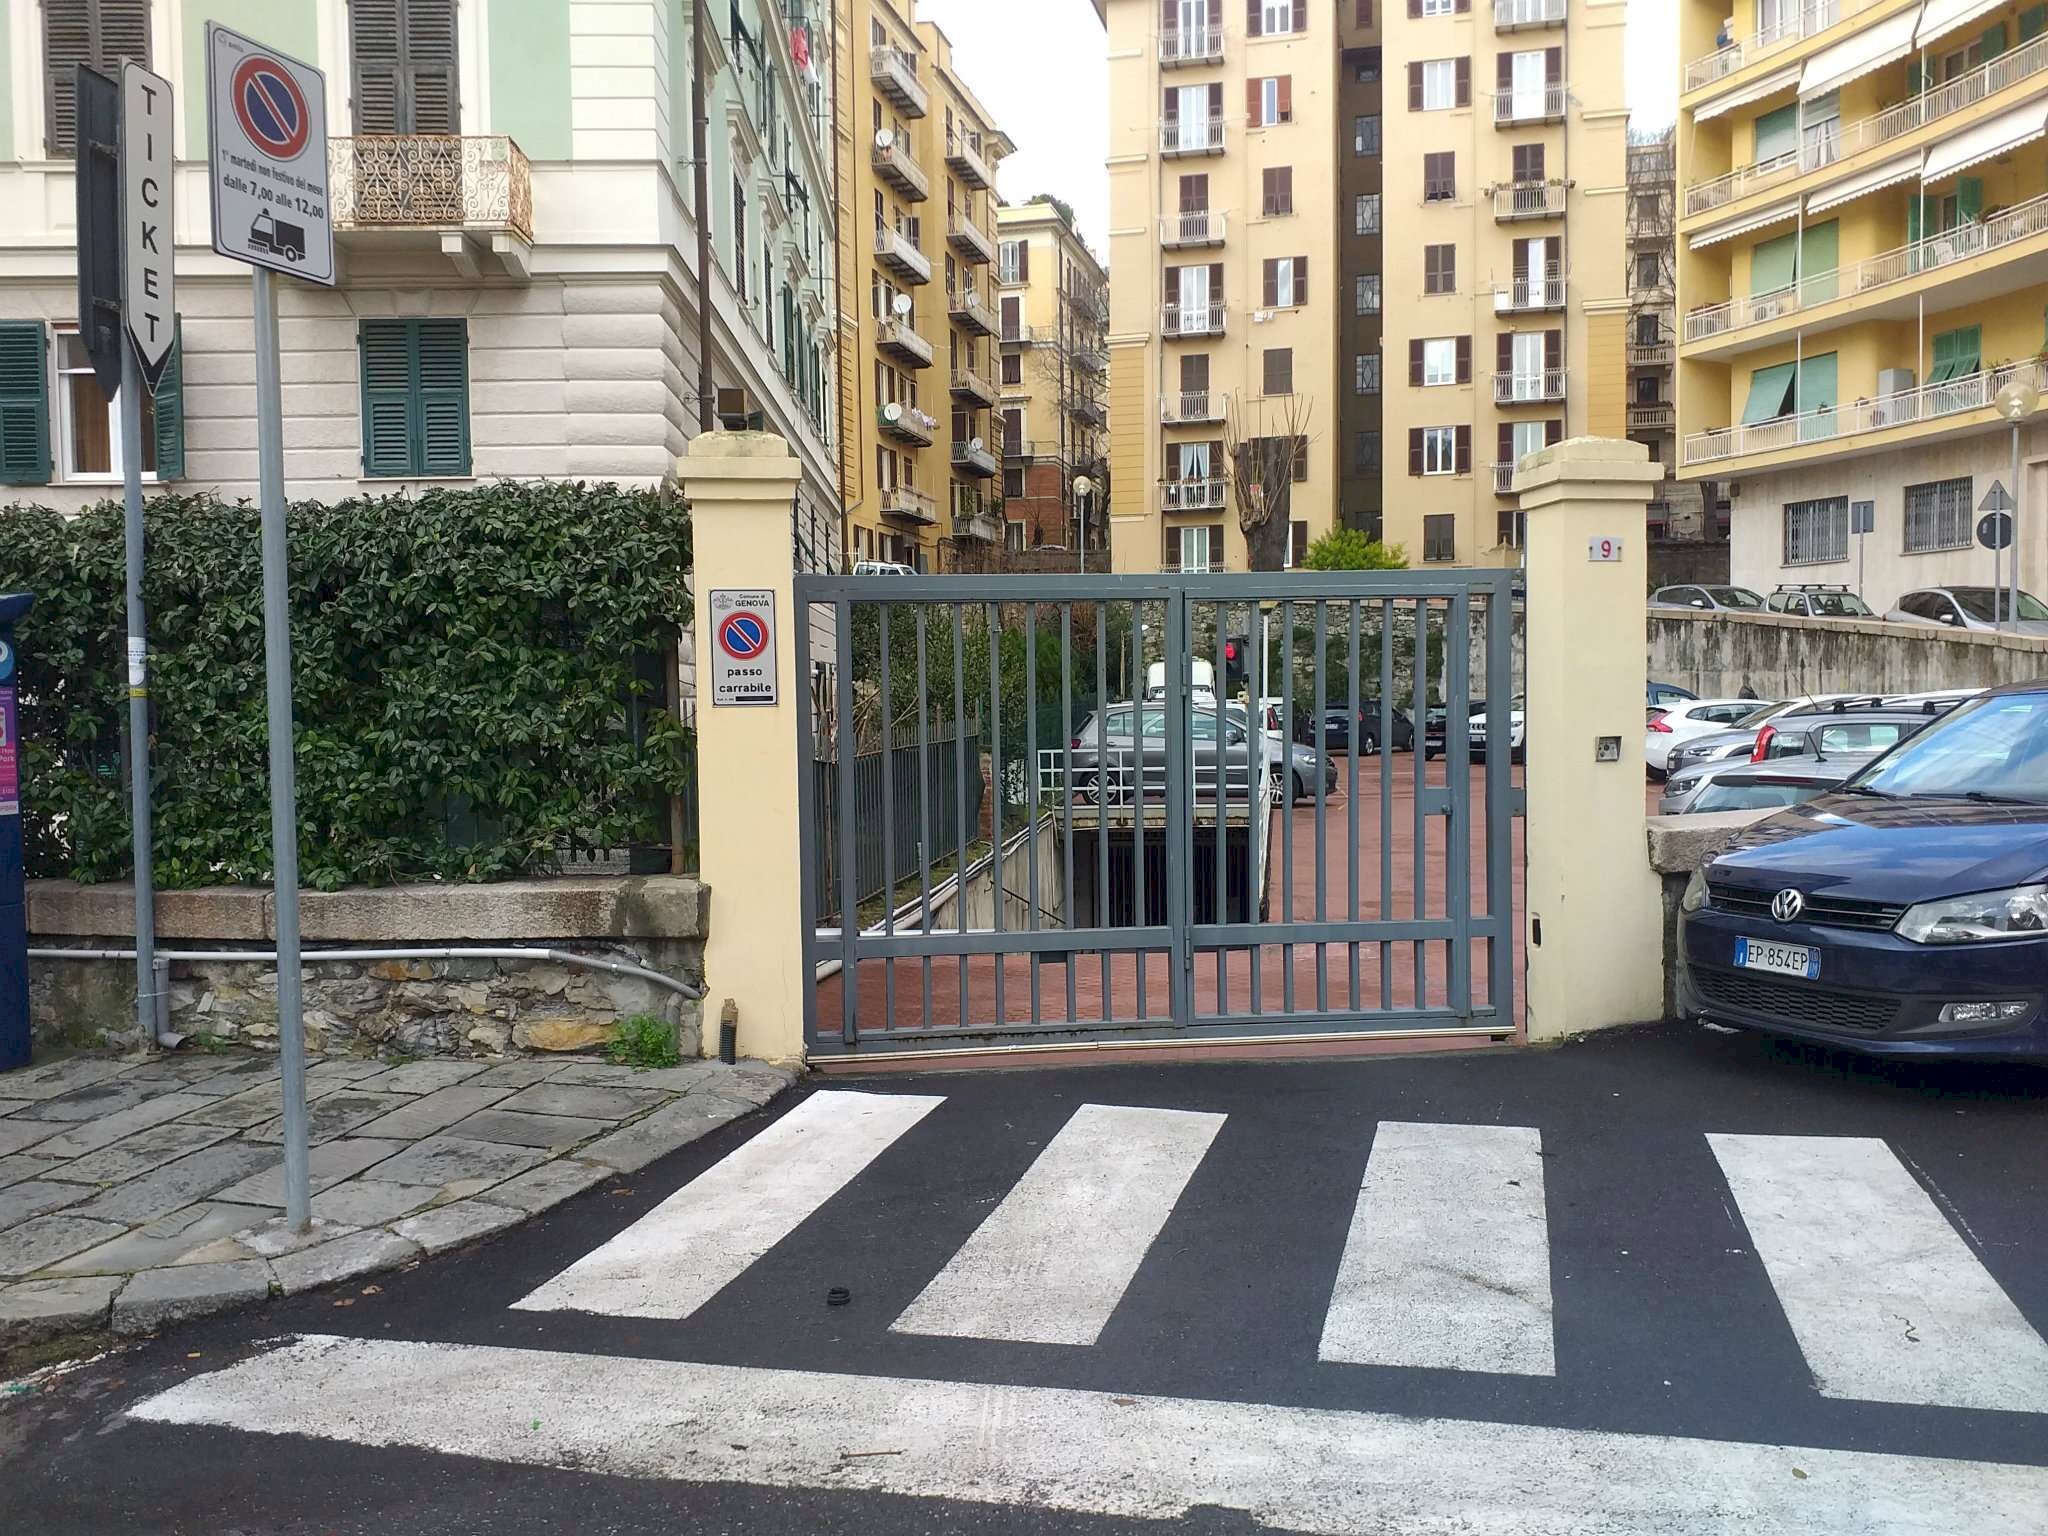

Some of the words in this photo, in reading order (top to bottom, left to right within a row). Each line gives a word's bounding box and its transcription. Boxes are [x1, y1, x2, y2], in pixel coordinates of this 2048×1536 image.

[258, 165, 271, 178] non
[295, 176, 306, 190] del
[307, 182, 323, 197] mese
[223, 173, 248, 193] dalle
[250, 181, 273, 201] 7,00
[275, 194, 293, 208] alle
[295, 197, 324, 219] 12,00
[141, 84, 160, 343] TICKET
[1601, 540, 1611, 558] 9
[735, 599, 770, 607] GENOVA
[727, 668, 763, 679] passo
[719, 683, 772, 693] carrabile
[1747, 944, 1764, 964] EP
[1767, 947, 1808, 972] 854EP
